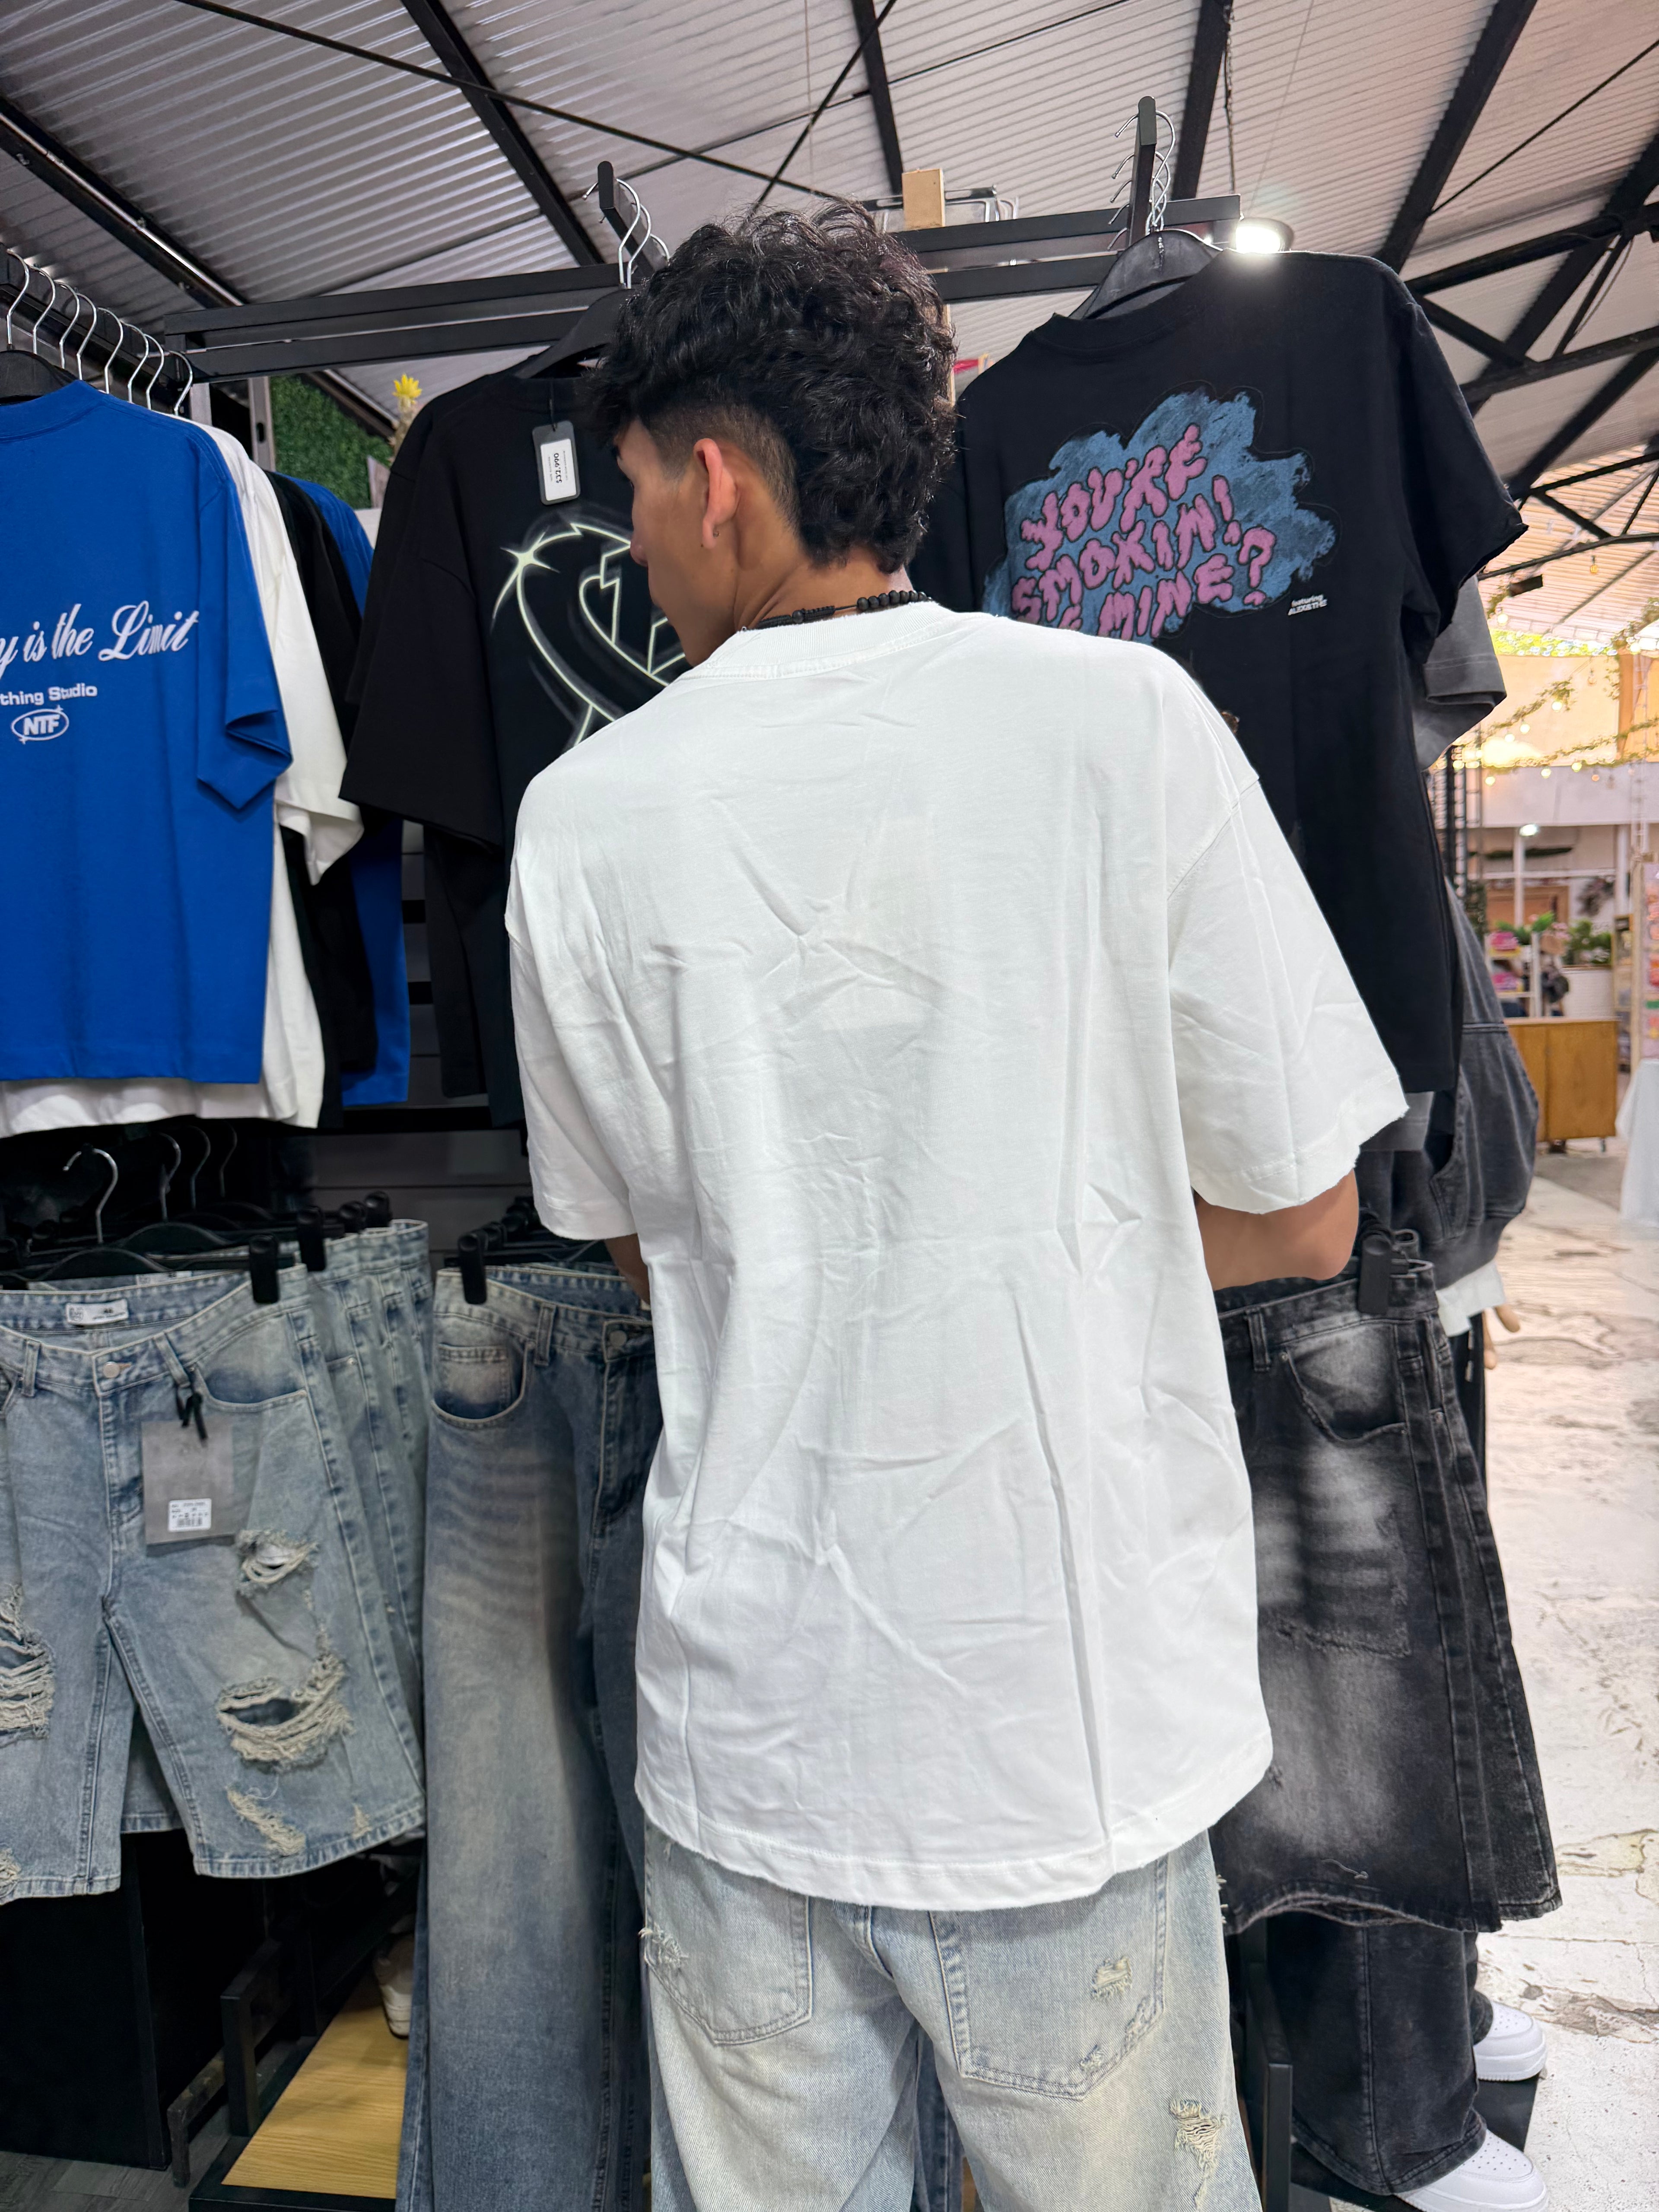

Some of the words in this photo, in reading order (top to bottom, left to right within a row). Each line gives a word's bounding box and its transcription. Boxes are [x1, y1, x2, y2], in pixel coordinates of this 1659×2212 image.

[23, 621, 47, 662] is
[51, 603, 94, 660] the
[99, 600, 199, 661] Limit
[0, 690, 44, 706] thing
[48, 683, 98, 702] Studio
[23, 714, 60, 735] NTF
